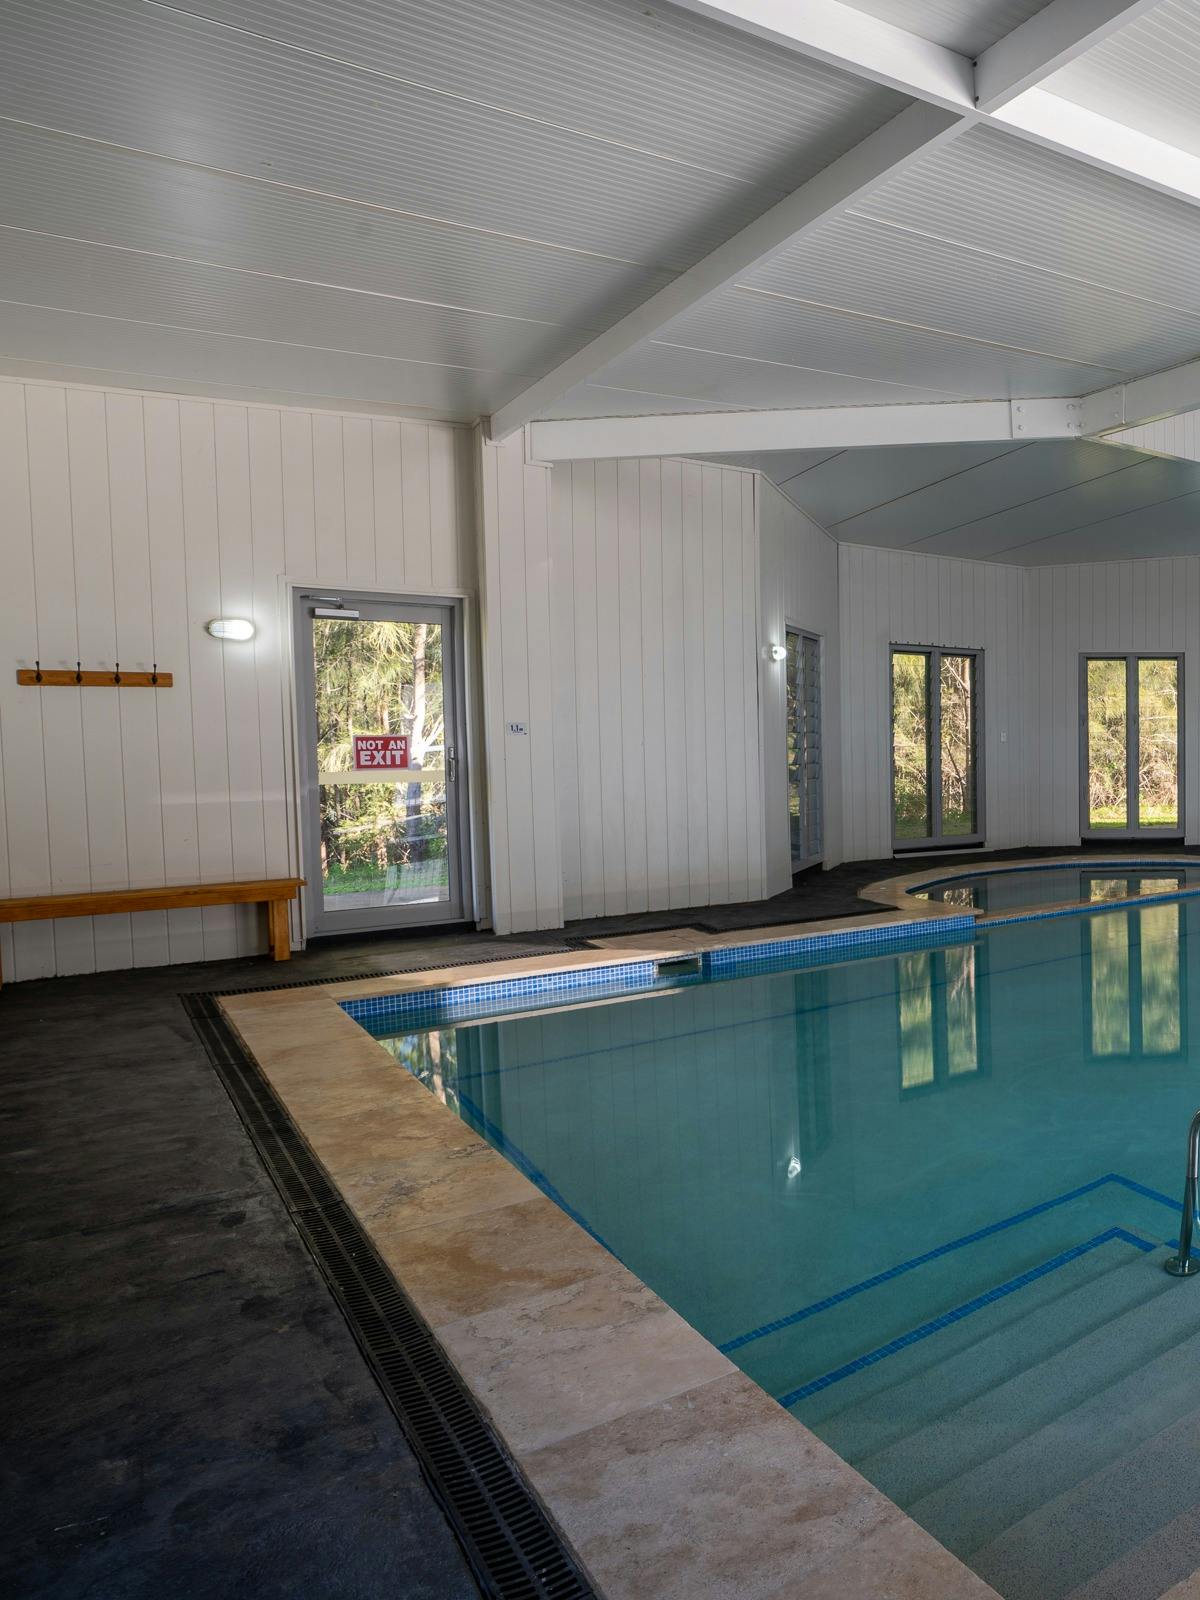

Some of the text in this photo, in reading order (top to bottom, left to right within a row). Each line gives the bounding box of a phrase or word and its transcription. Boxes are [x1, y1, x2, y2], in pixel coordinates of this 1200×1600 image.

[357, 740, 406, 750] NOT AN
[360, 750, 404, 766] EXIT
